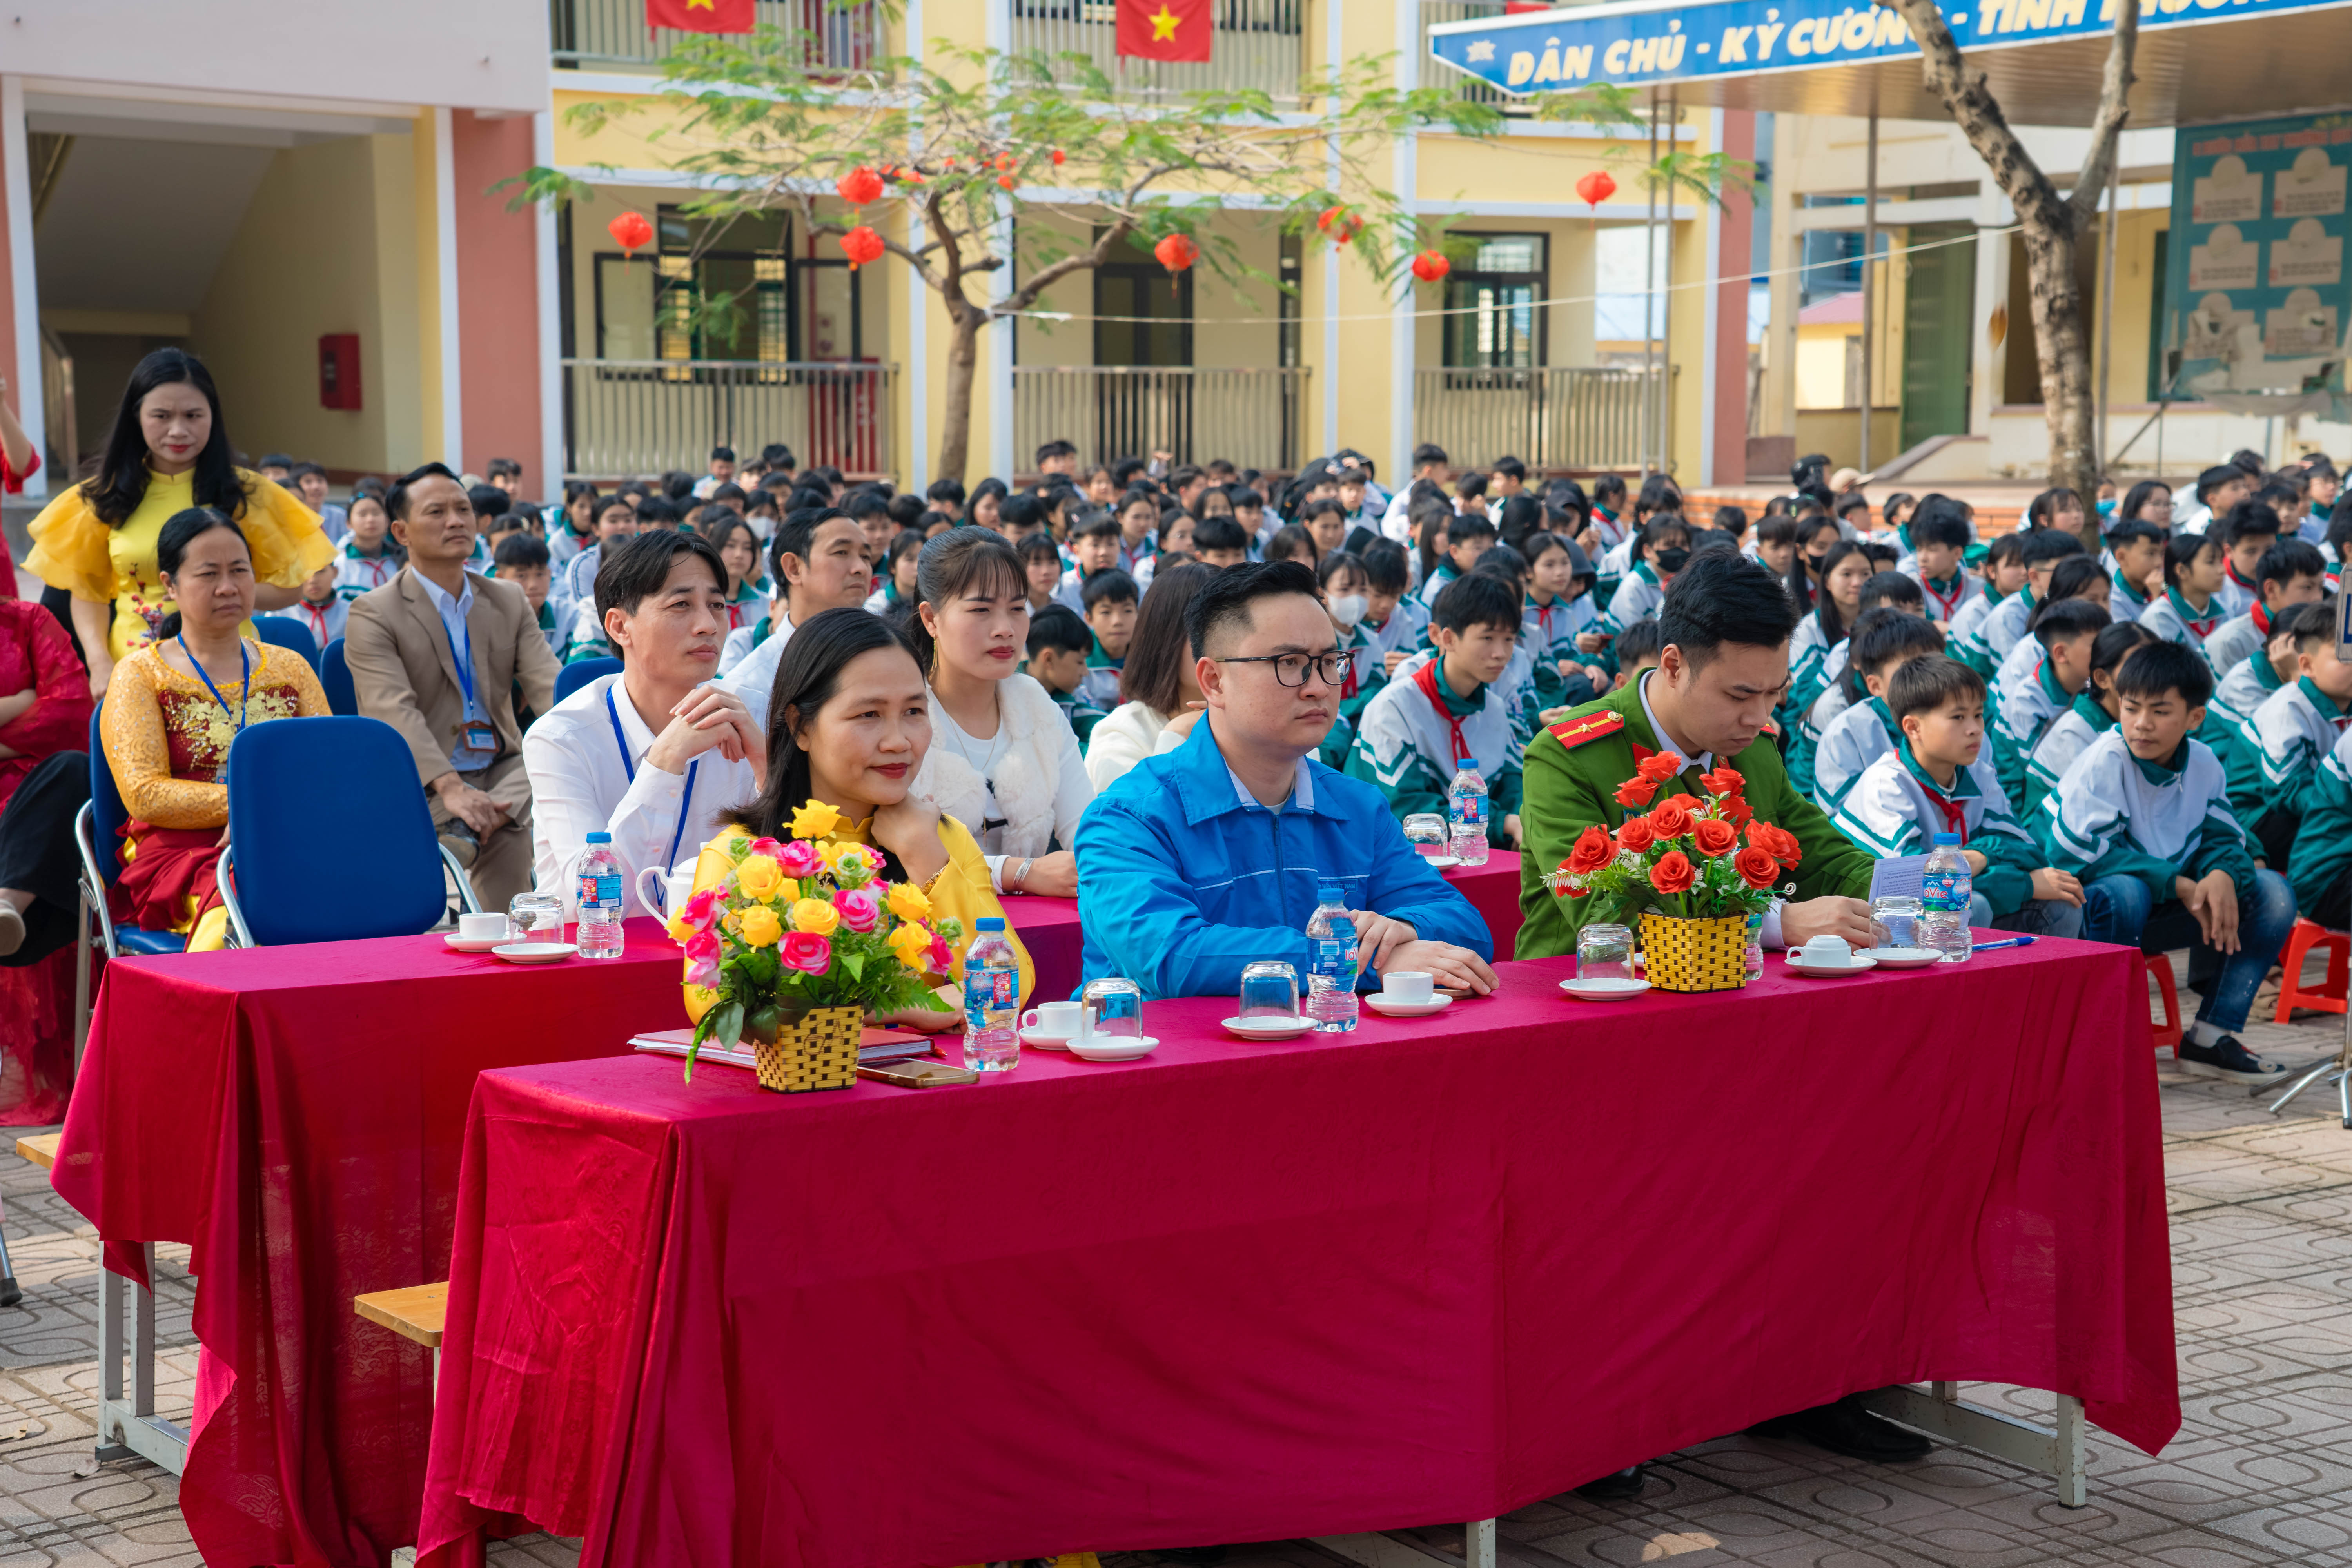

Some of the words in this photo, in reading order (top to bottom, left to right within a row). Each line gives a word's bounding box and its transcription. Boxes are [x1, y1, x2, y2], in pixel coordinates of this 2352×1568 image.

[1508, 36, 1594, 86] DÂN
[1604, 19, 1686, 74] CHỦ
[1719, 8, 1785, 64] KỶ
[1787, 4, 1942, 57] CƯƠN
[1924, 886, 1948, 899] aVie
[1345, 947, 1357, 961] laV
